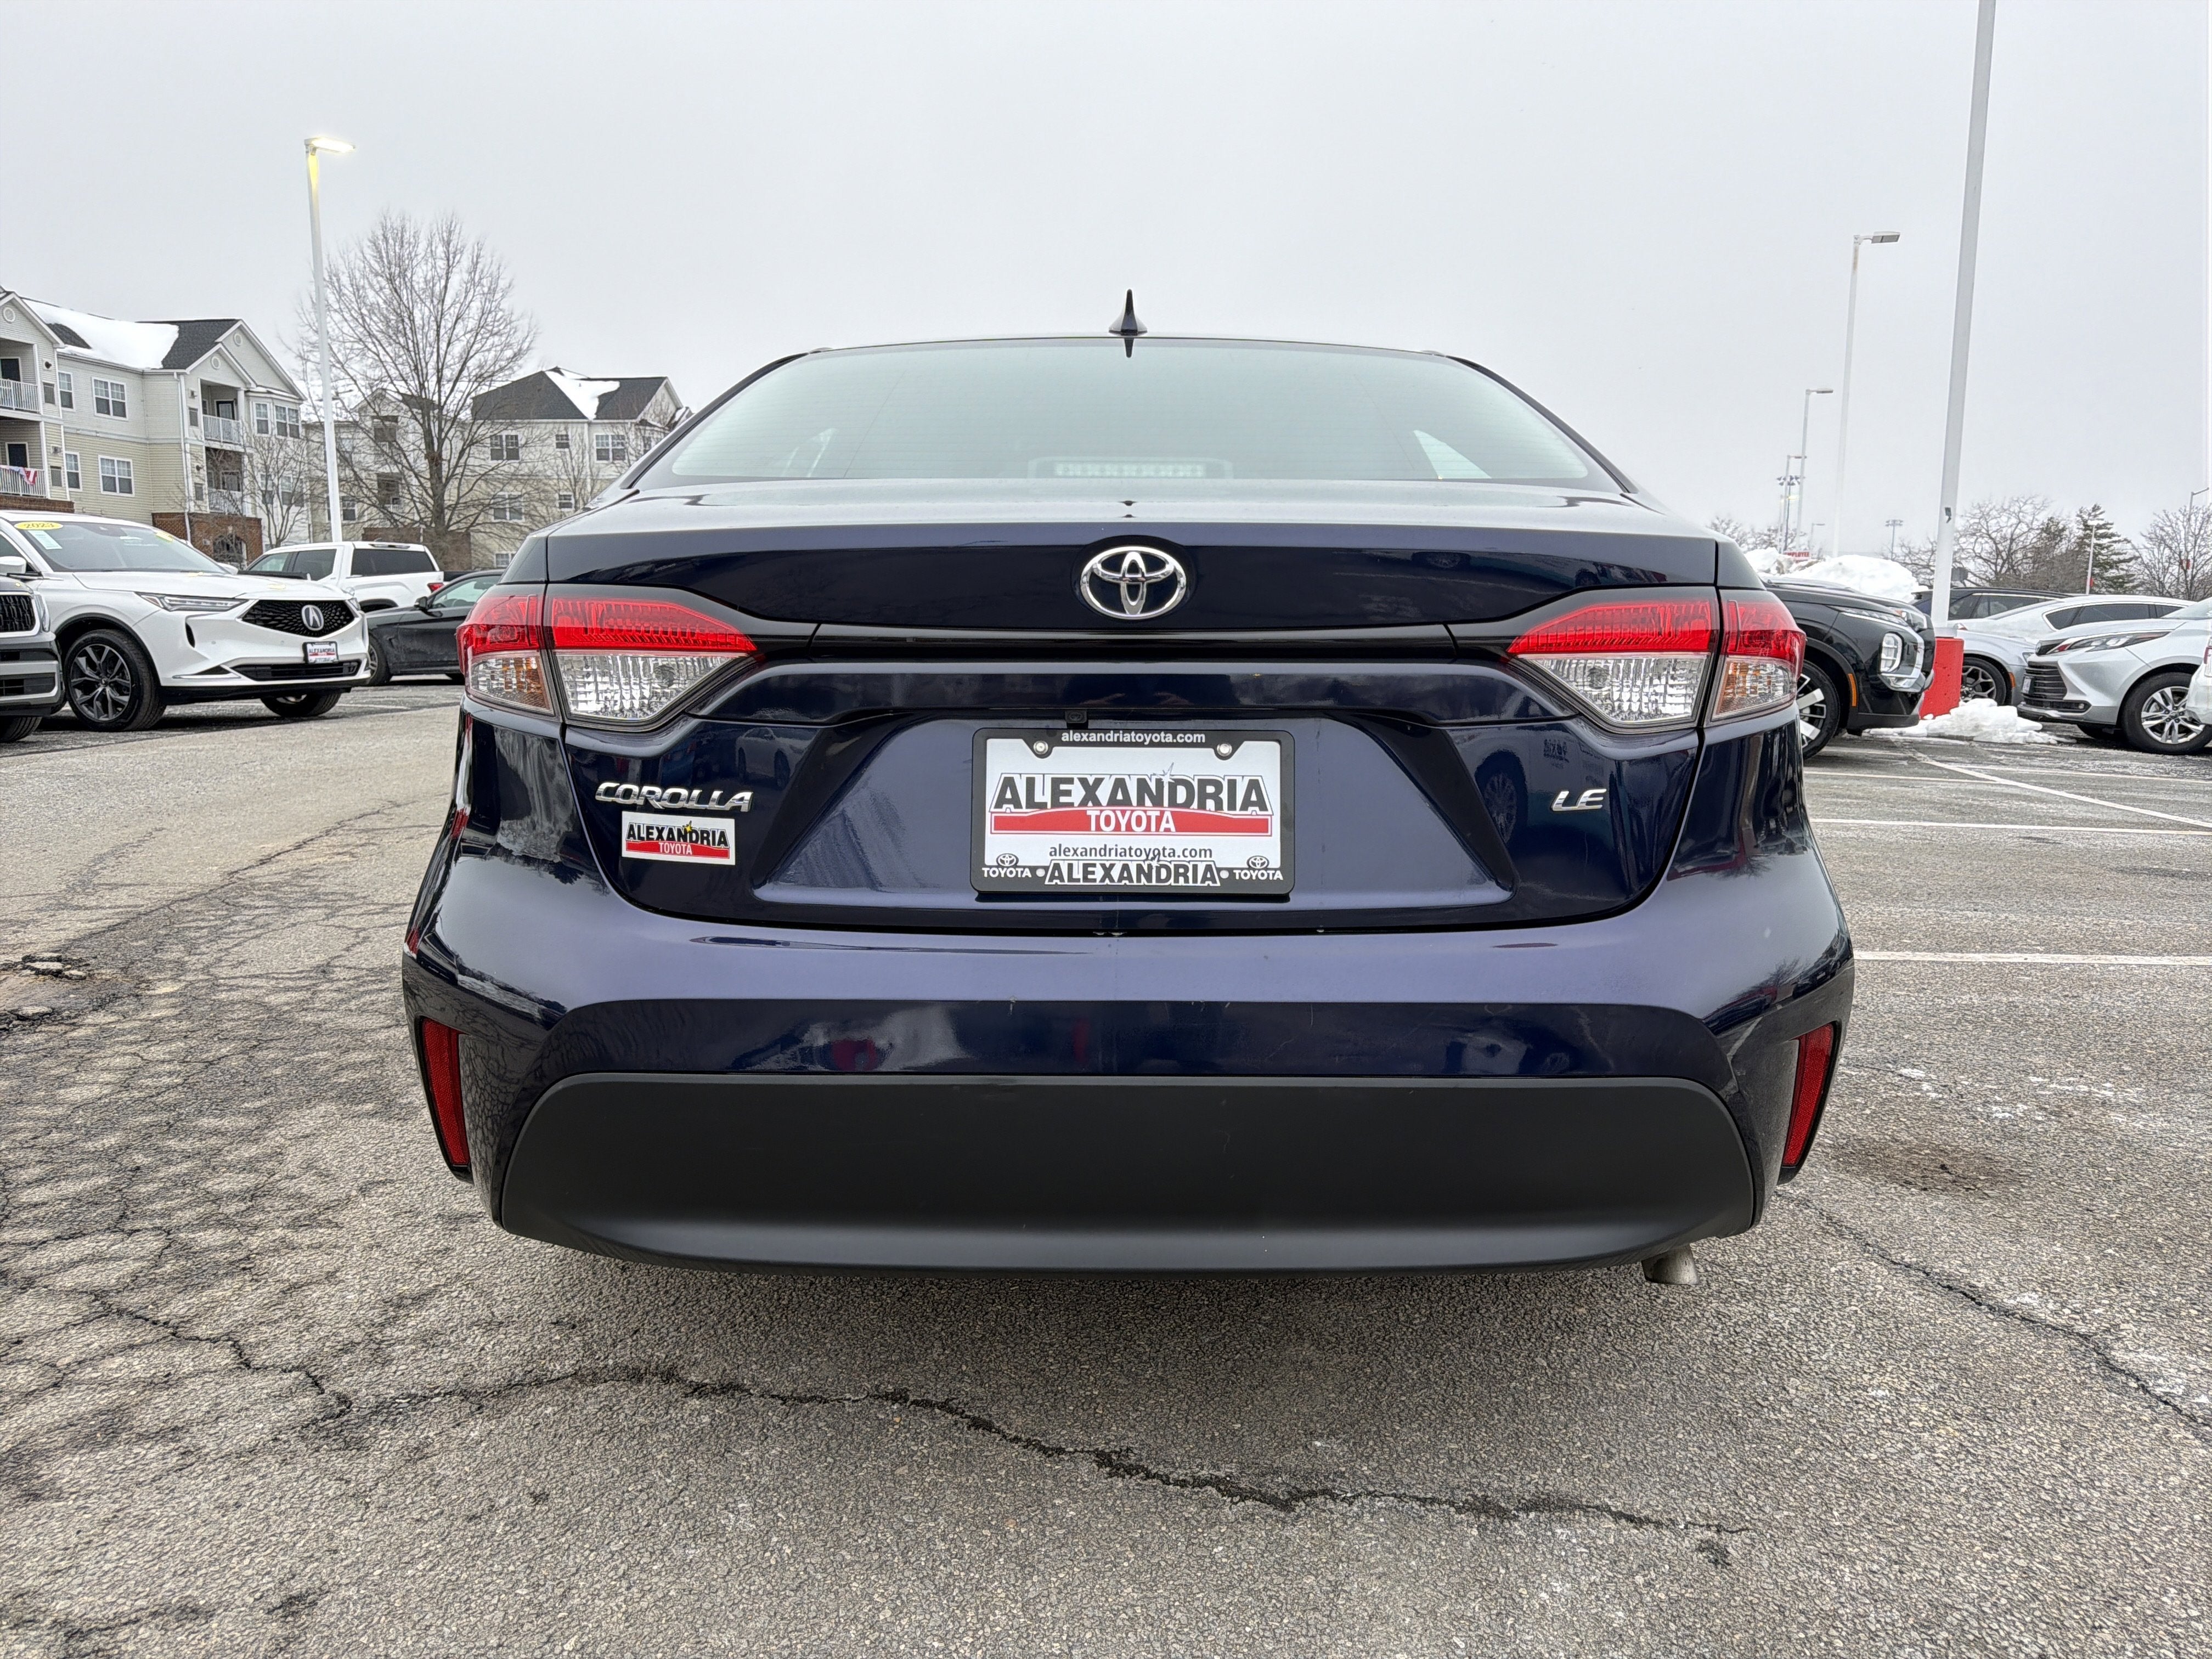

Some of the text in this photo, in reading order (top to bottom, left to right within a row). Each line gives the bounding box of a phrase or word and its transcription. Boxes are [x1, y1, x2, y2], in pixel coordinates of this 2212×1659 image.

[1061, 730, 1206, 745] alexandriatoyota.com
[595, 782, 754, 812] COROLLA
[992, 775, 1270, 812] ALEXANDRIA
[1550, 788, 1607, 811] LE
[1086, 809, 1176, 833] TOYOTA
[627, 823, 729, 848] ALEXANDRIA
[658, 842, 693, 855] TOYOTA
[1048, 843, 1213, 860] alexandriatoyota.com
[981, 861, 1284, 886] TOYOTA ALEXANDRIA TOYOTA
